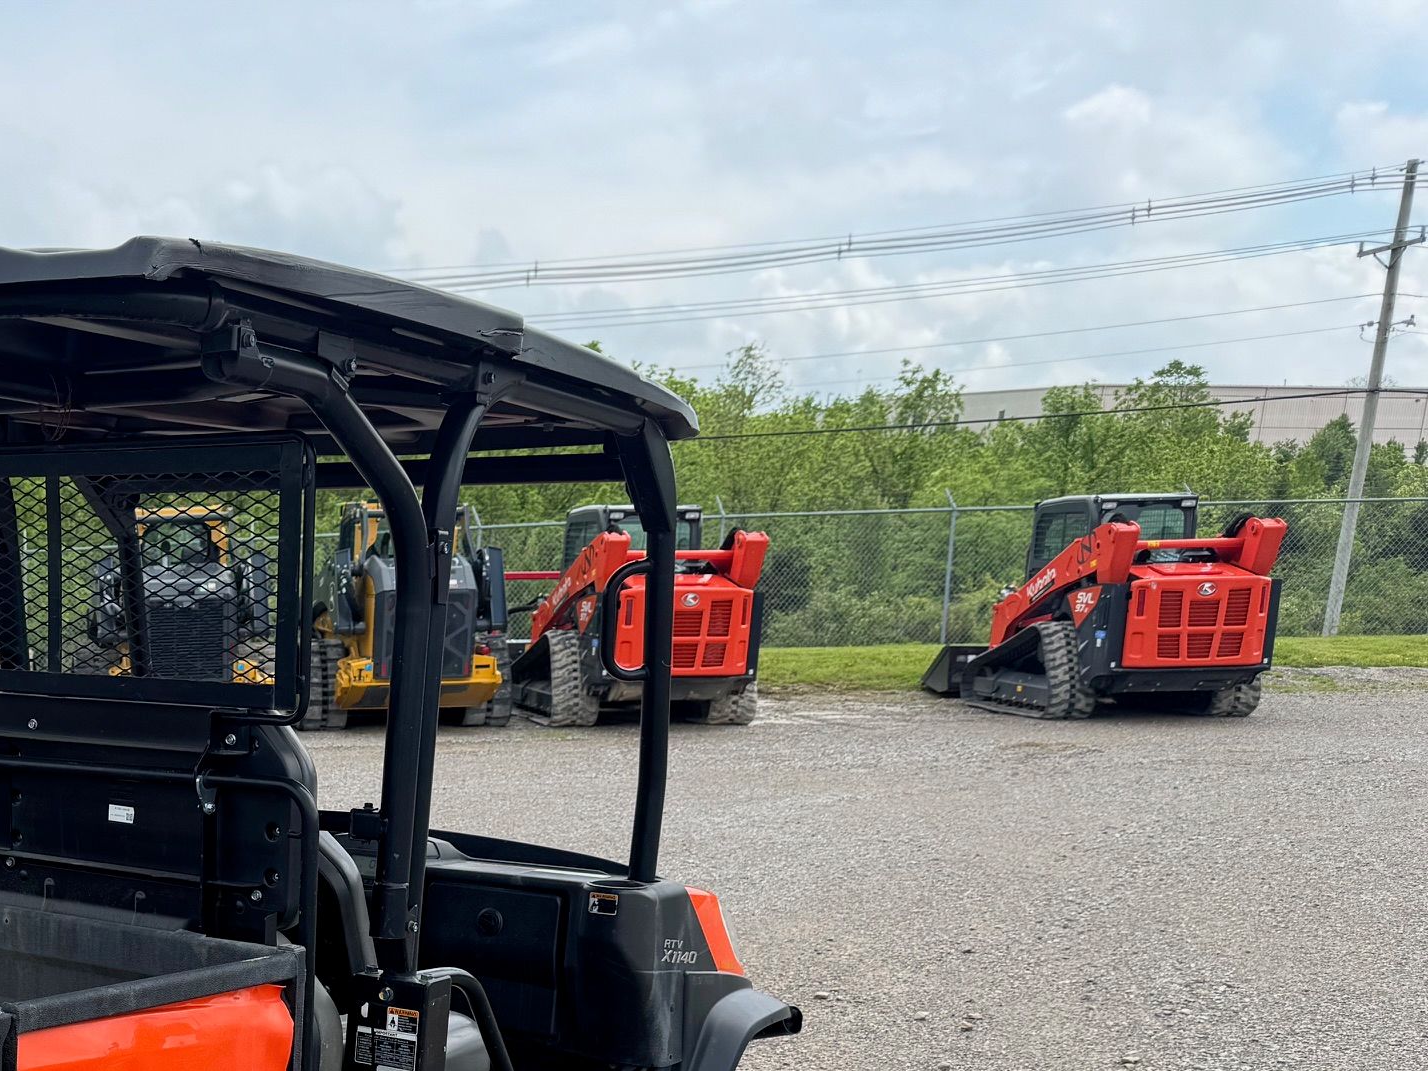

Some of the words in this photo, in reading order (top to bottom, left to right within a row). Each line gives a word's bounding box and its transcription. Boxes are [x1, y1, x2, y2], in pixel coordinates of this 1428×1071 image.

[1026, 568, 1056, 597] Kubota
[1075, 591, 1094, 604] SVL
[664, 939, 684, 948] RTV
[661, 949, 697, 963] X1140
